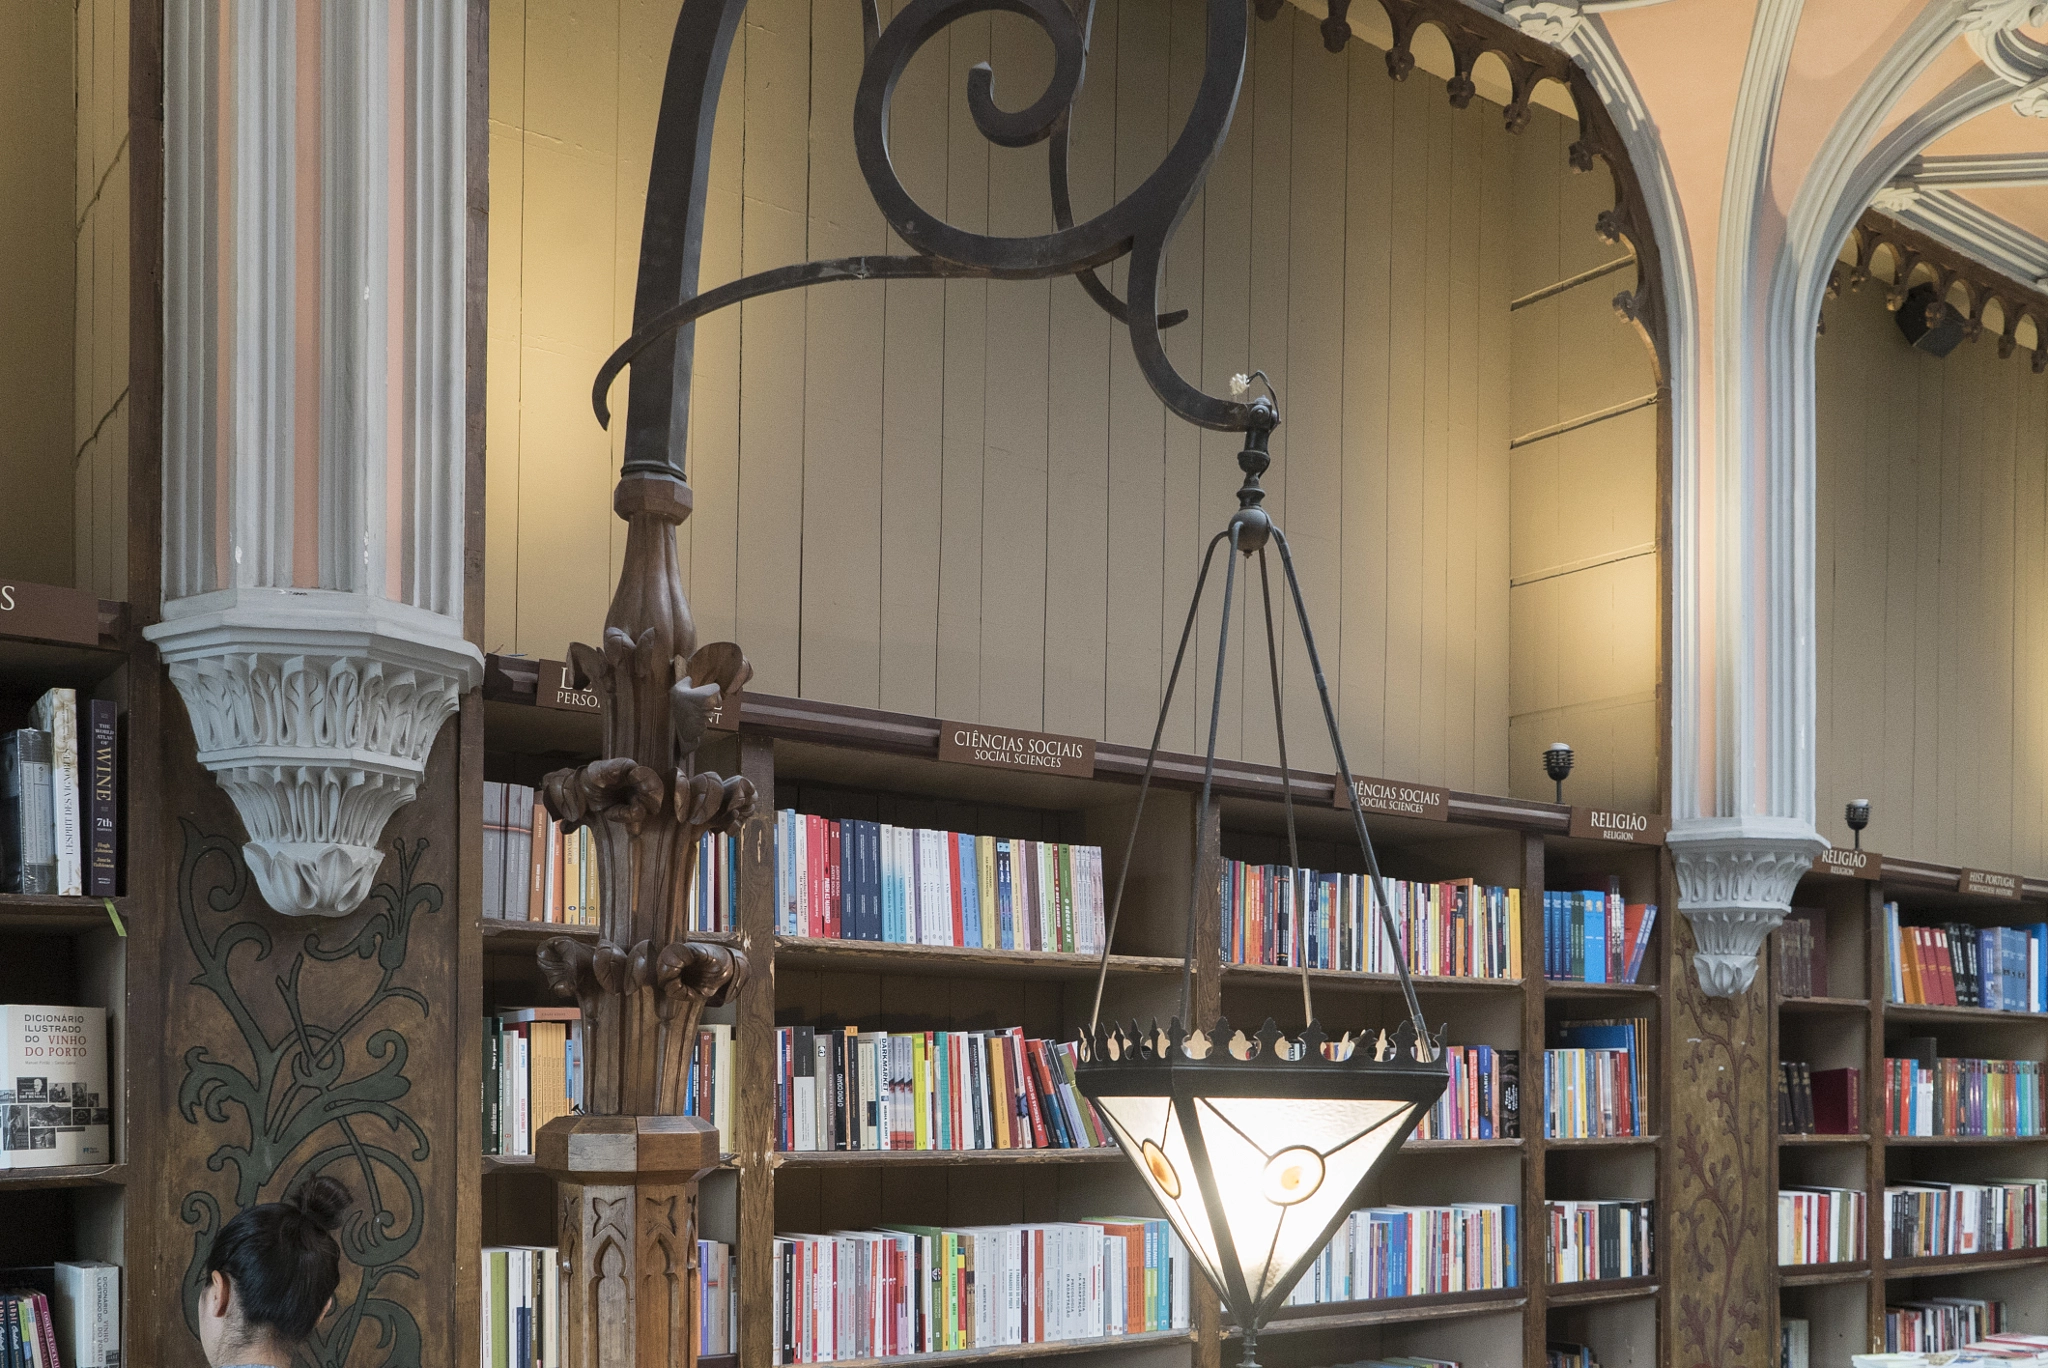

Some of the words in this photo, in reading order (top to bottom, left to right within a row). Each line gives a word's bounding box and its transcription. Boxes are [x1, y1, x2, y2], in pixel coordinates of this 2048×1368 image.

[954, 730, 1023, 752] CIÊNCIAS
[1028, 739, 1083, 759] SOCIAIS
[974, 750, 1012, 762] SOCIAL
[1014, 754, 1062, 768] SCIENCES
[62, 748, 72, 797] VIGNOBLES
[96, 747, 111, 801] WINE
[1352, 780, 1397, 800] IÊNCIAS
[1399, 788, 1440, 806] SOCIAIS
[63, 798, 73, 816] DES
[1360, 797, 1387, 809] SOCIAL
[1389, 800, 1424, 814] SCIENCES
[96, 817, 113, 828] 7th
[1591, 811, 1647, 831] RELIGIÃO
[63, 819, 74, 855] L'ESPRIT
[1603, 830, 1634, 841] RELIGION
[1822, 850, 1867, 868] RELIGIÃO
[1830, 865, 1855, 877] RELIGION
[1985, 873, 2015, 888] PORTUGAL
[1066, 933, 1072, 943] XX
[25, 1013, 84, 1023] DICIONÁRIO
[25, 1025, 81, 1033] ILUSTRADO
[48, 1036, 87, 1045] VINHO
[25, 1047, 44, 1057] DO
[48, 1047, 87, 1057] PORTO
[1032, 1100, 1040, 1123] TÉCNICAS
[1078, 1273, 1082, 1281] DA
